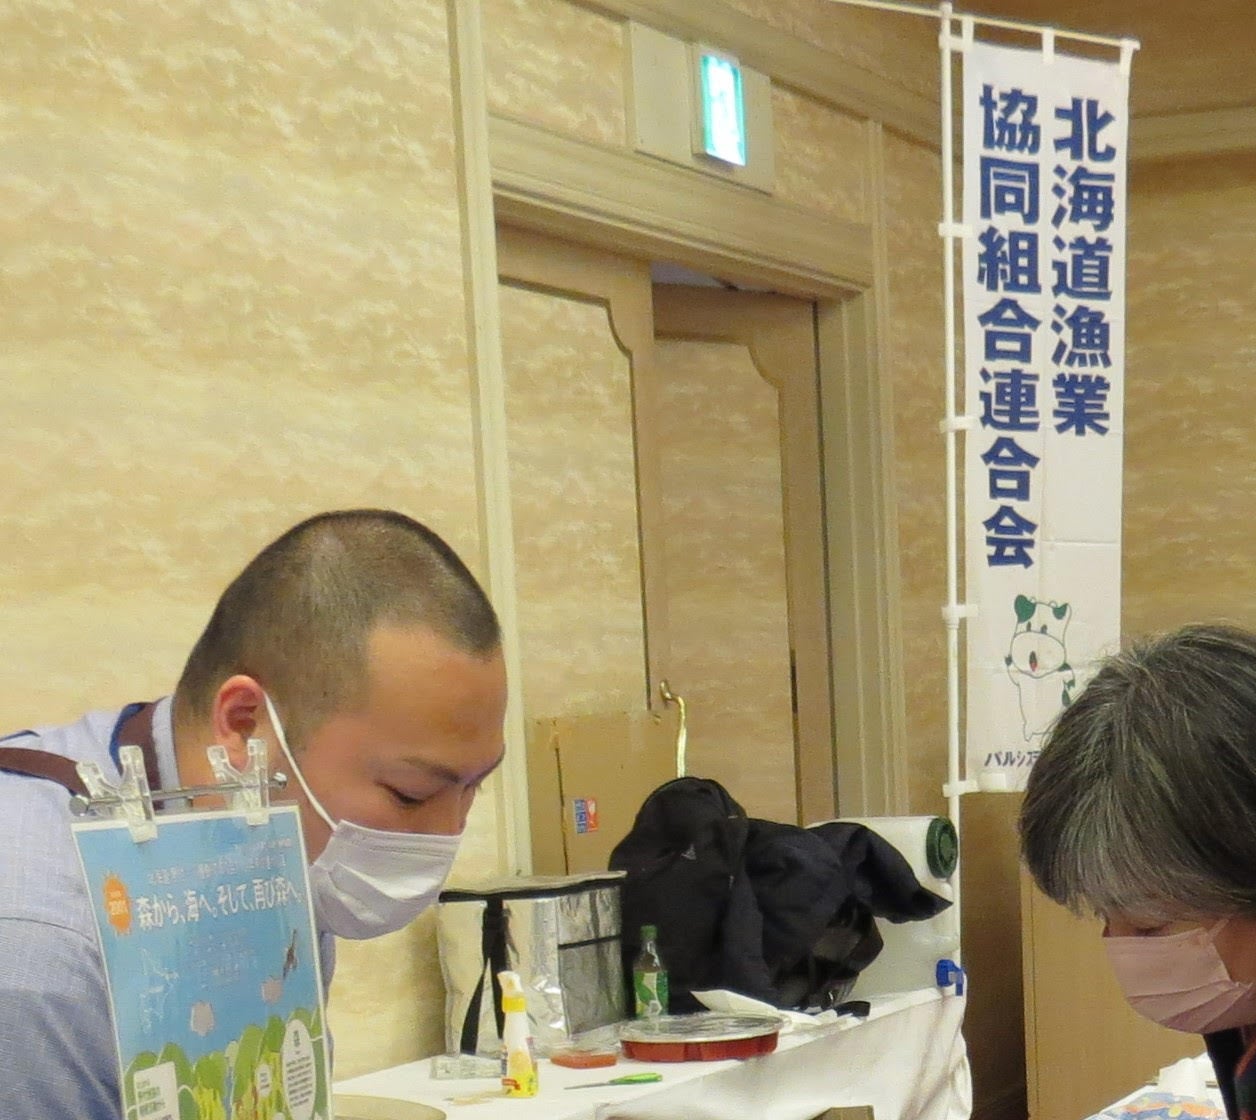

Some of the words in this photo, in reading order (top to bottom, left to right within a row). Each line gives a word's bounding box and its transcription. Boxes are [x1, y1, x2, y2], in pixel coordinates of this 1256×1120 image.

[977, 84, 1041, 570] 協同組合連合会
[1051, 97, 1116, 436] 北海道漁業
